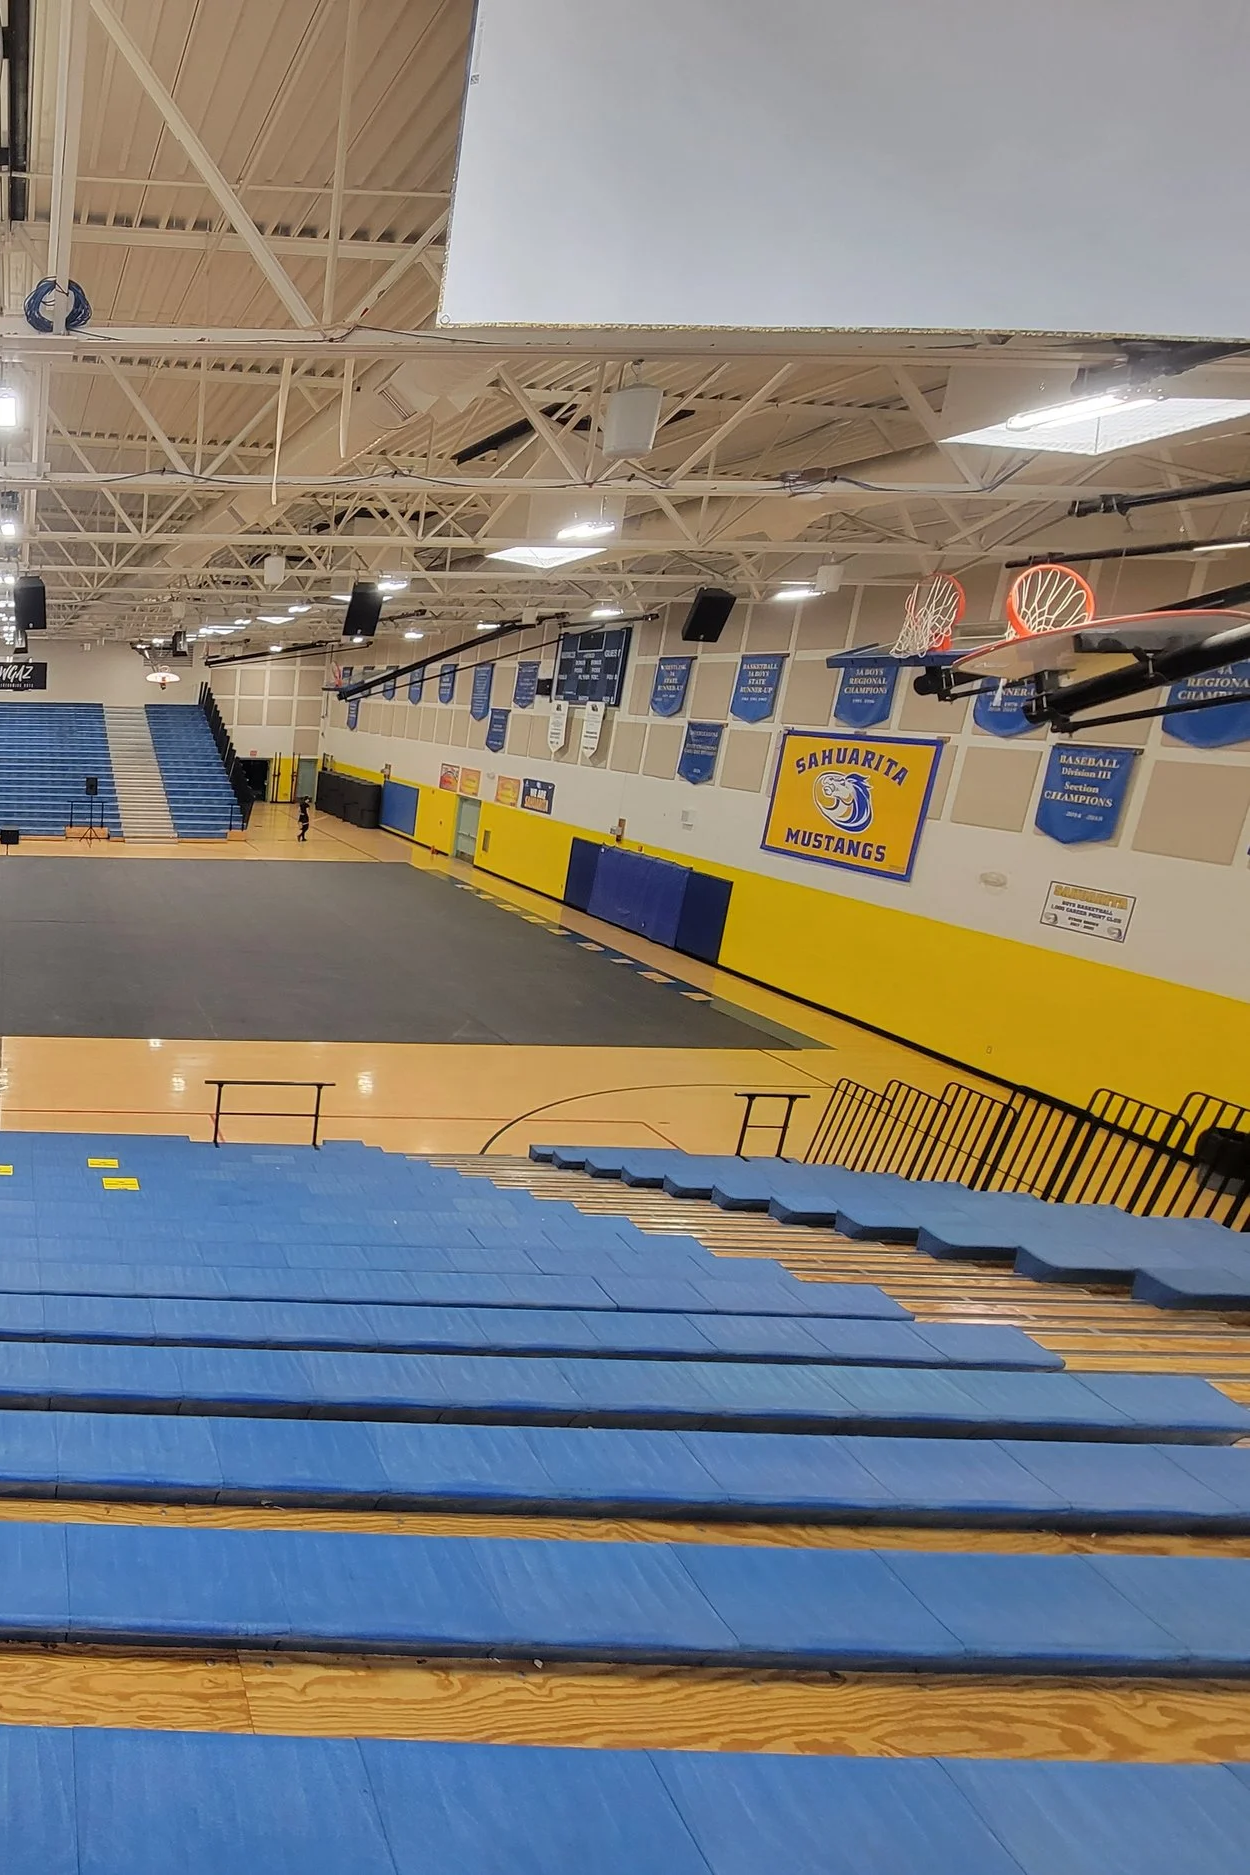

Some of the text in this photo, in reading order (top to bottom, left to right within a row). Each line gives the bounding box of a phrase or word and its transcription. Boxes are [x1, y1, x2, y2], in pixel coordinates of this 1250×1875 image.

[742, 663, 779, 671] BASKETBALL
[754, 670, 770, 678] BOYS
[866, 668, 884, 677] BOYS
[748, 678, 767, 686] STATE
[849, 677, 888, 686] REGIONAL
[1187, 677, 1250, 688] REGIONA
[739, 686, 773, 694] RUNNER-UP
[843, 686, 888, 695] CHAMPIONS
[795, 748, 909, 786] SAHUARITA
[1059, 755, 1120, 769] BASEBALL
[1062, 767, 1111, 780] Division III
[1064, 781, 1099, 794] Section
[1044, 790, 1113, 808] CHAMPIONS
[785, 827, 886, 863] MUSTANGS
